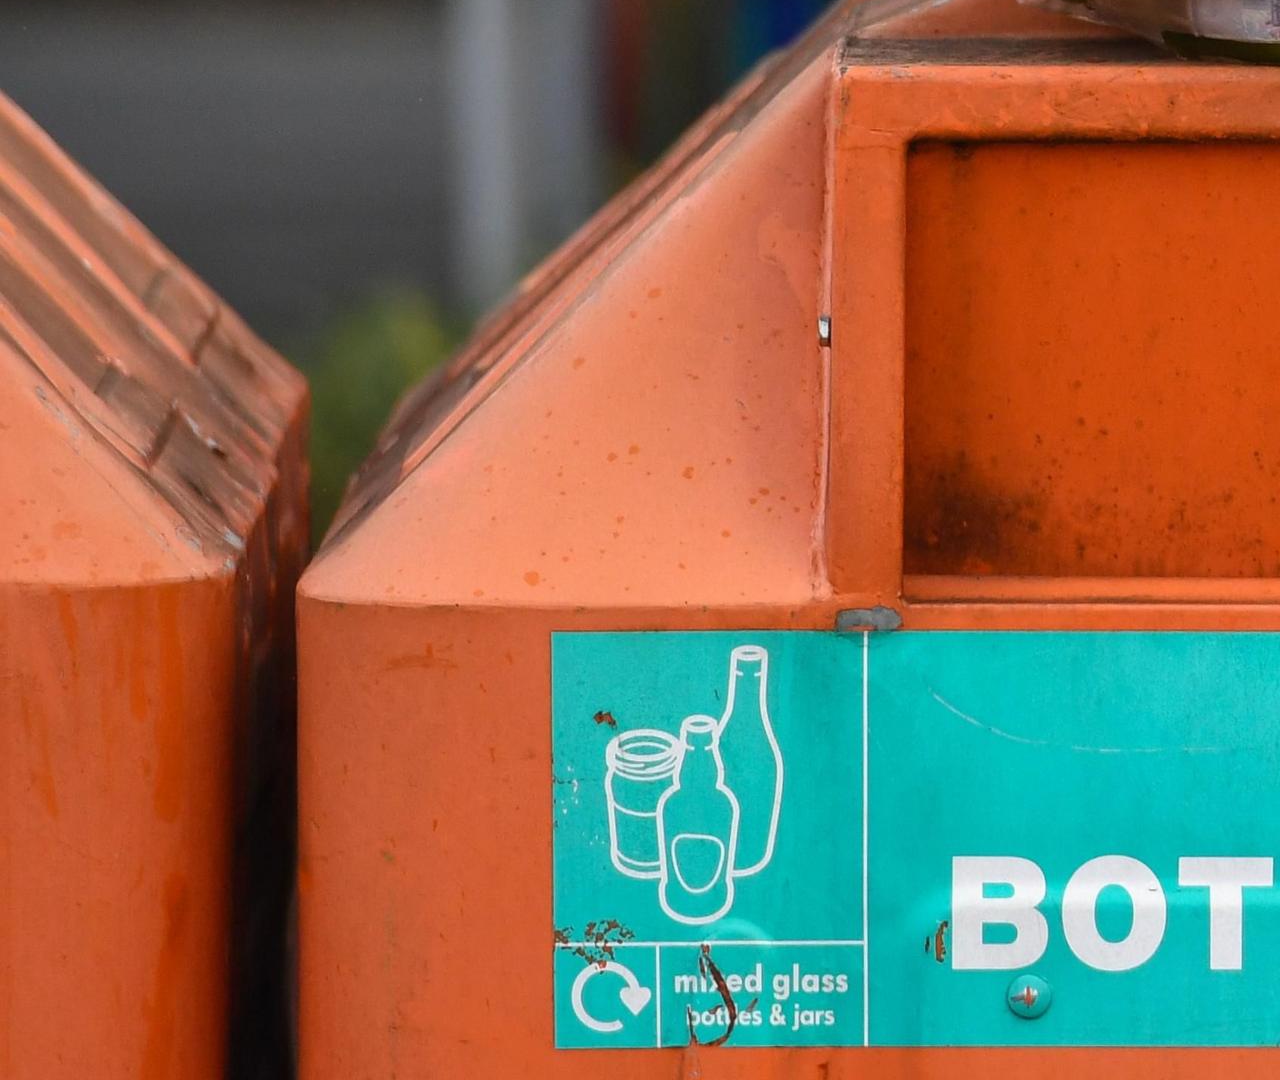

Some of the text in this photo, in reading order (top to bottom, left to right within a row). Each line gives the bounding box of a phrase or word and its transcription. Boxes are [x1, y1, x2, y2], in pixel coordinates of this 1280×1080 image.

[772, 963, 849, 1001] glass
[768, 1004, 787, 1026] &
[791, 1004, 836, 1032] jars
